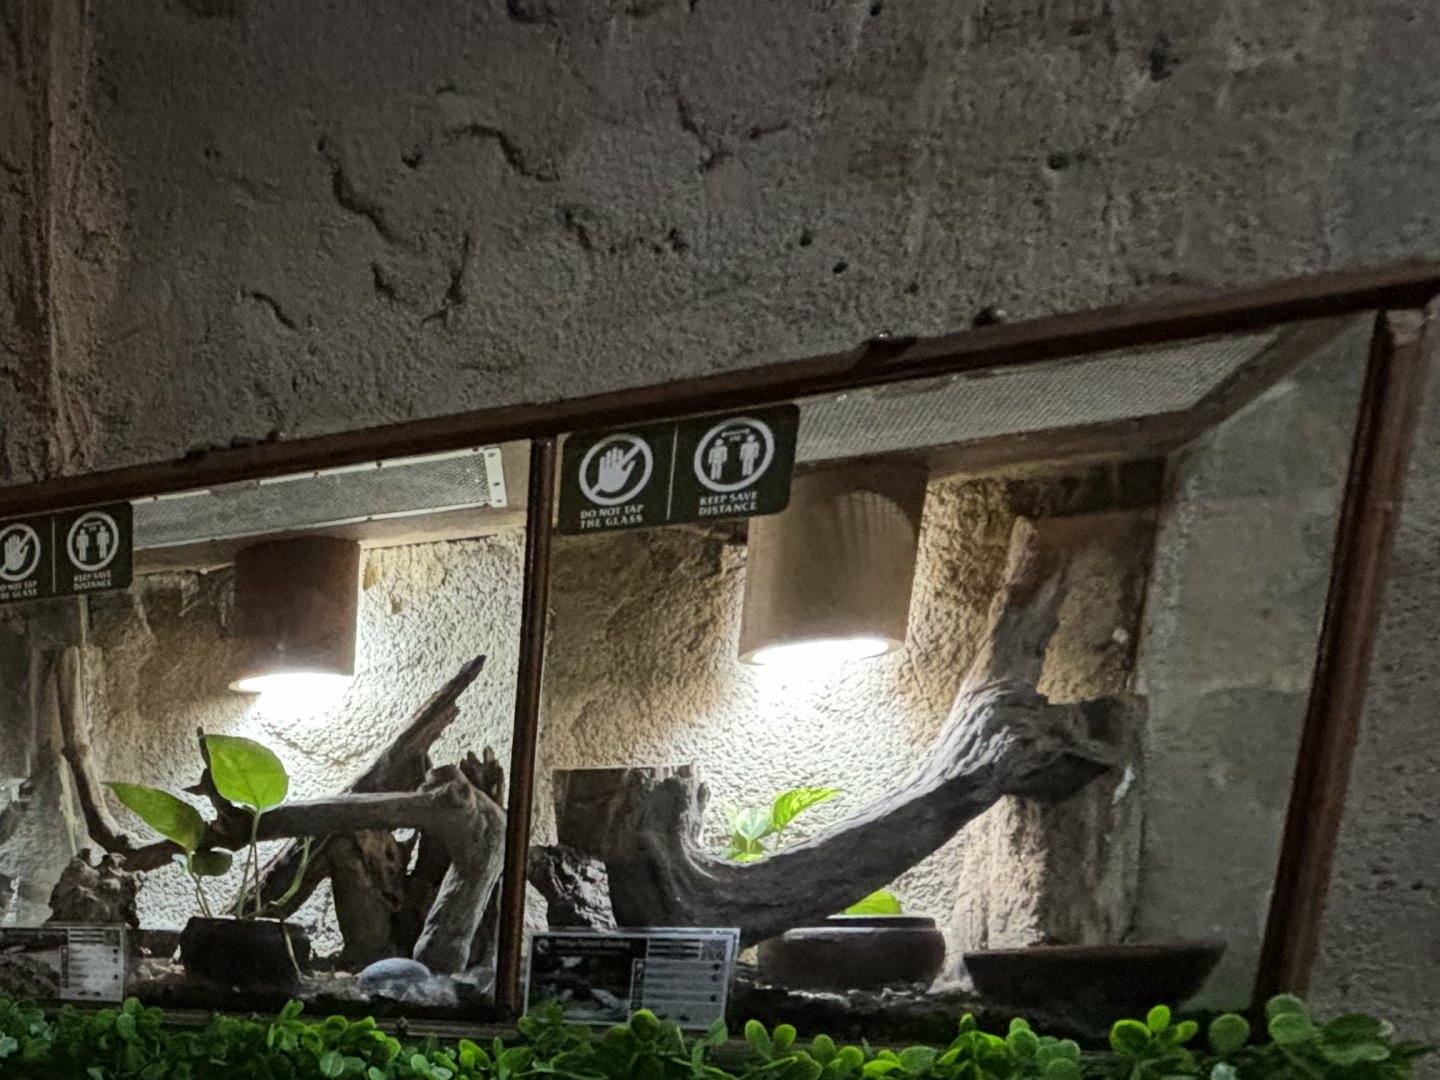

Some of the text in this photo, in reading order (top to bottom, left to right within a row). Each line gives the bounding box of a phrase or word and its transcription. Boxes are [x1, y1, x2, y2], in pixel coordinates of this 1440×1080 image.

[700, 491, 757, 505] KEEP SAVE
[581, 504, 644, 519] DO NOT TAP
[699, 502, 757, 515] DISTANCE
[580, 513, 643, 529] THE GLASS
